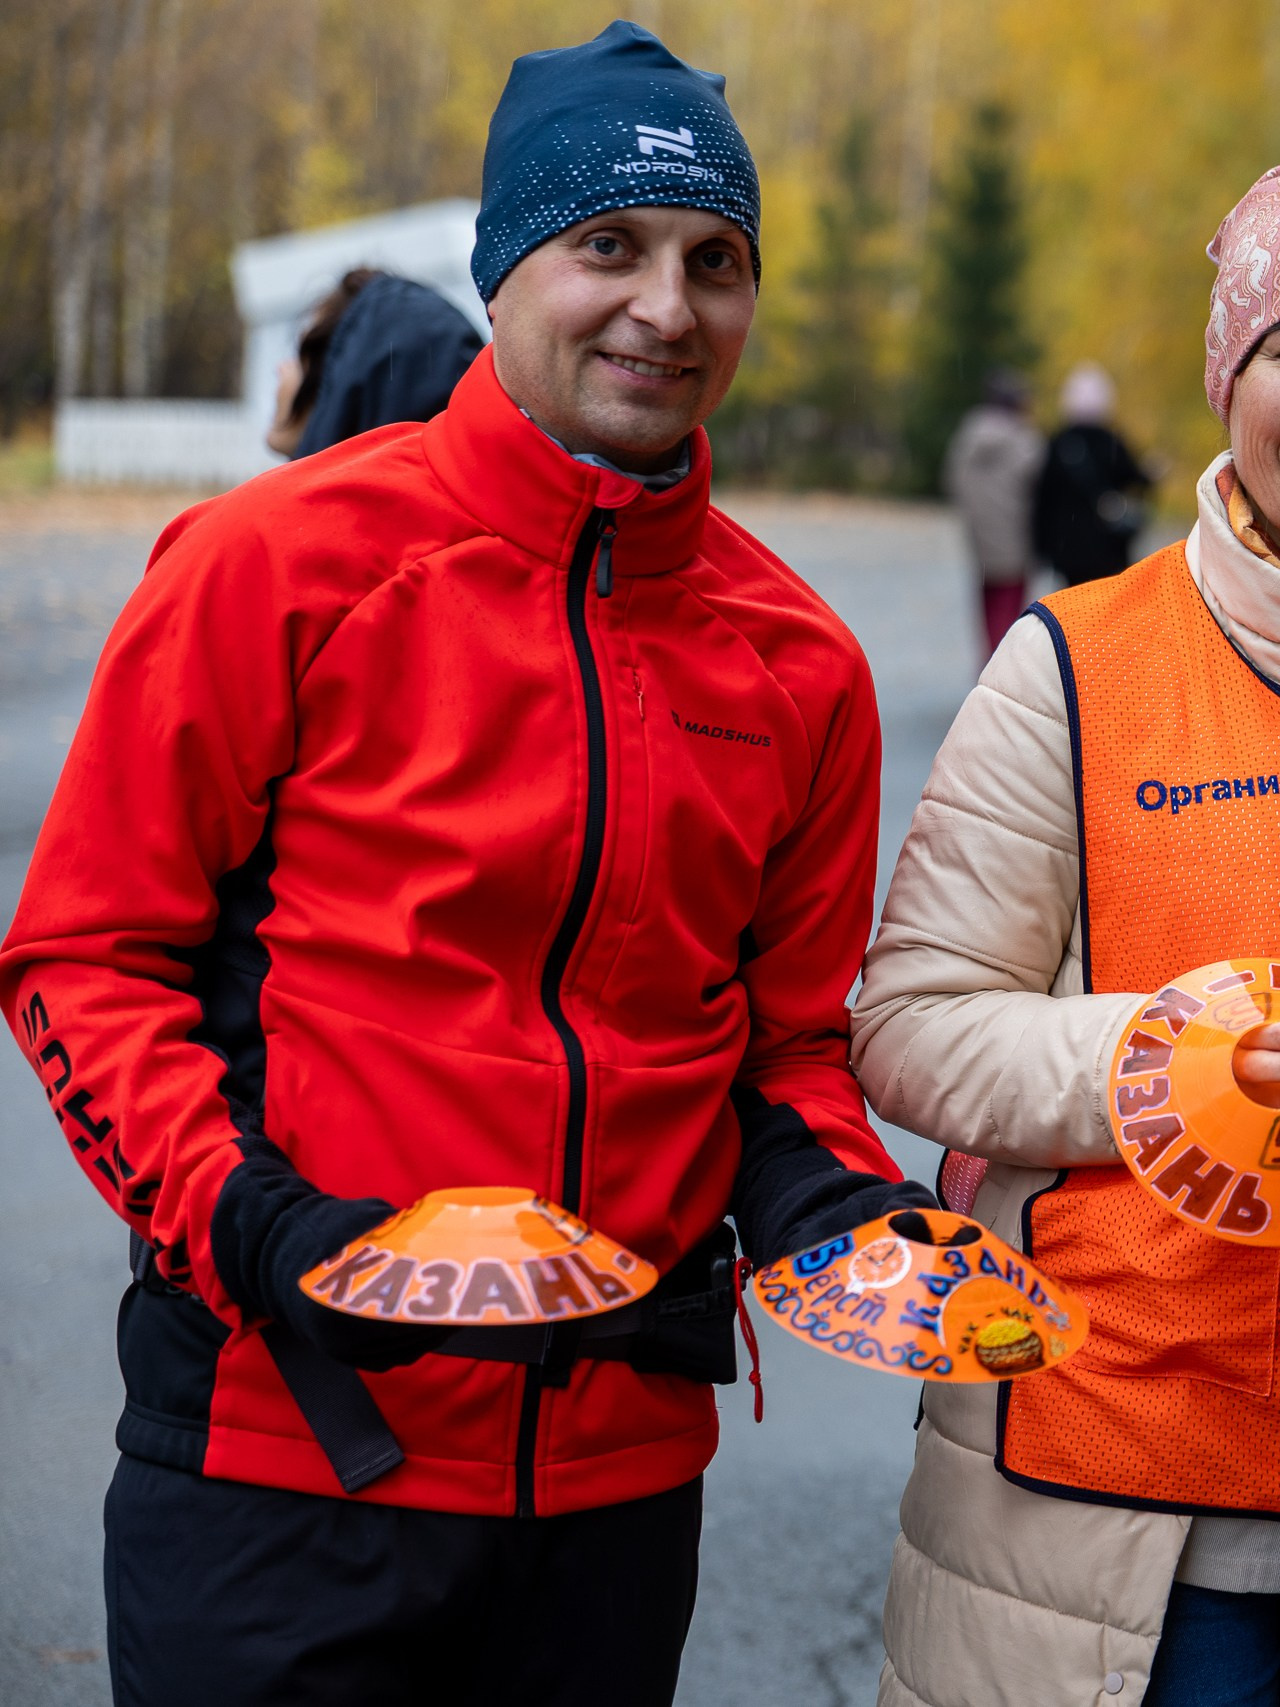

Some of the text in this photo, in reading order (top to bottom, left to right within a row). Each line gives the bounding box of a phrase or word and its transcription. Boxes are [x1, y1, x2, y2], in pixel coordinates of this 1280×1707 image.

[612, 160, 725, 185] NORDSKI
[684, 720, 772, 748] MADSHUS
[1115, 987, 1272, 1237] КАЗАНЬ
[310, 1244, 637, 1322] КАЗАНЬ
